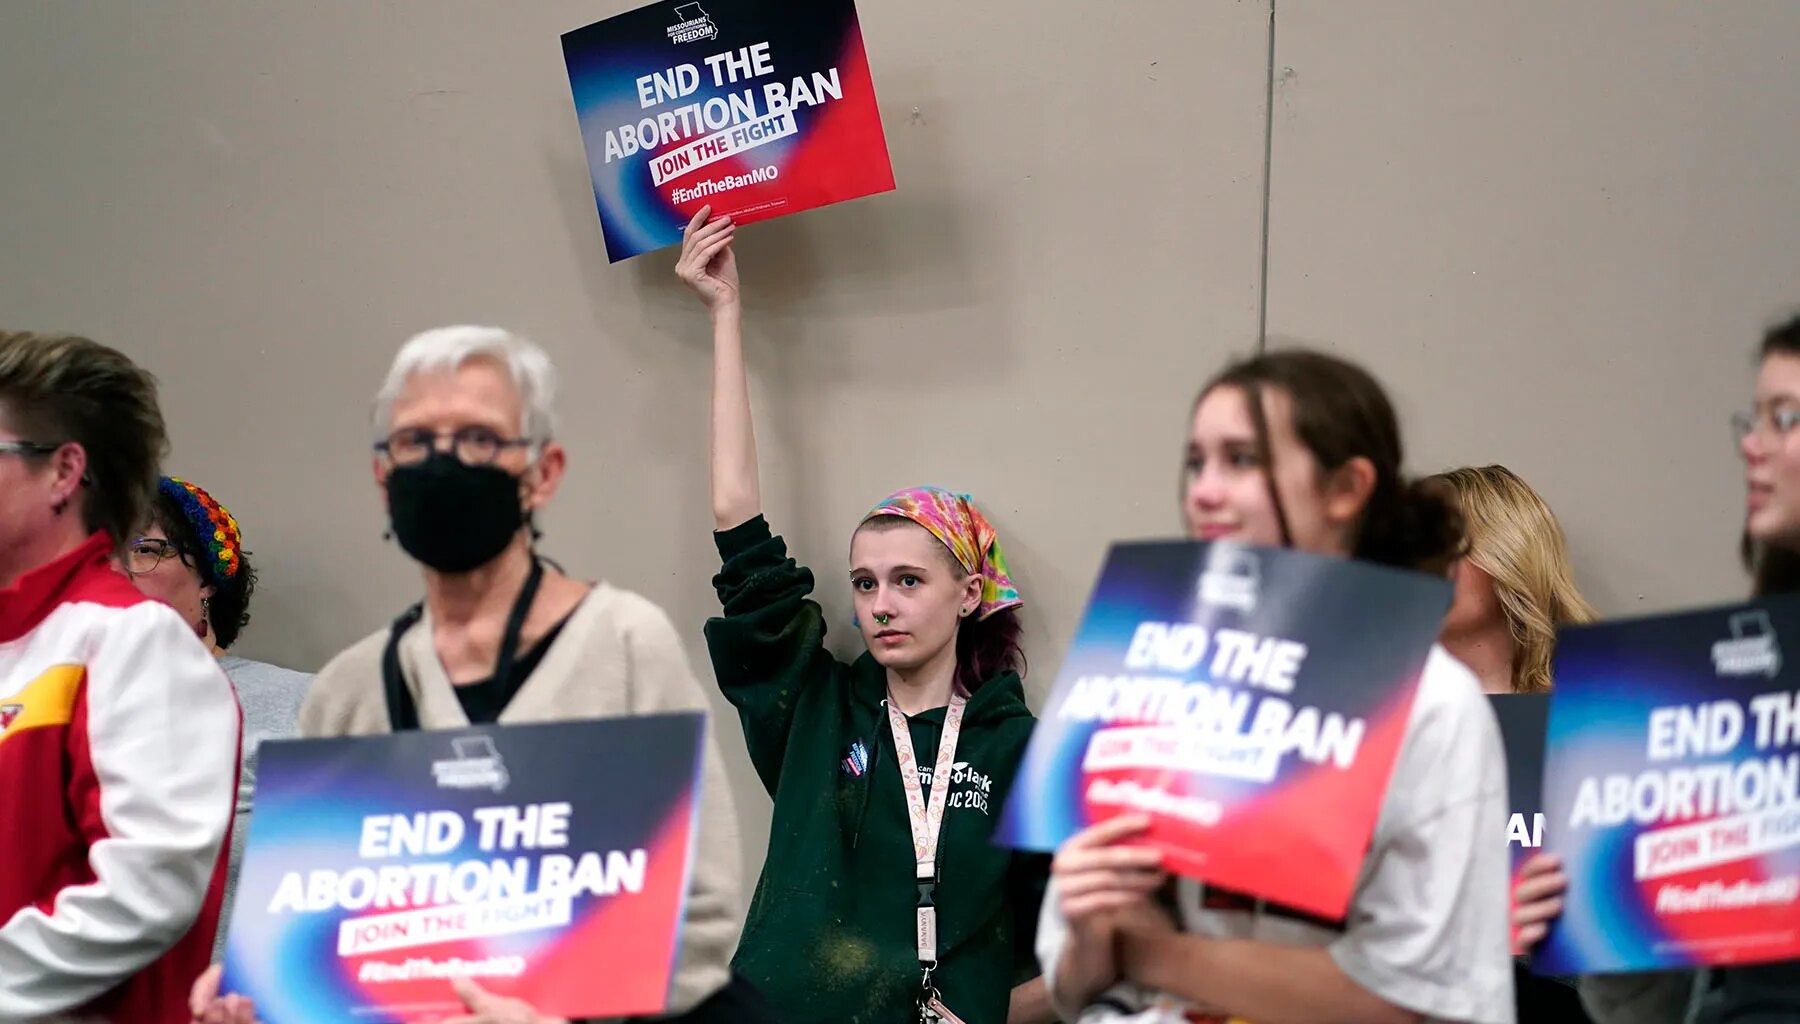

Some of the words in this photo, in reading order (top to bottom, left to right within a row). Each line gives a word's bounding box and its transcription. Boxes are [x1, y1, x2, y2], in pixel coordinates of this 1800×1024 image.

[667, 16, 706, 33] MISSOURIANS
[672, 25, 713, 44] FREEDOM
[636, 63, 700, 109] END
[705, 41, 774, 87] THE
[604, 88, 758, 164] ABORTION
[763, 67, 843, 118] BAN
[656, 147, 691, 182] JOIN
[694, 136, 728, 162] THE
[731, 115, 787, 152] FIGHT
[671, 165, 779, 205] #EndTheBanMO
[1124, 621, 1209, 672] END
[1210, 628, 1307, 693] THE
[1057, 675, 1251, 736] ABORTION
[1253, 697, 1366, 770] BAN
[1647, 700, 1744, 761] END
[1749, 690, 1800, 750] TH
[1569, 752, 1799, 828] ABORTION
[358, 811, 465, 858] END
[474, 803, 572, 851] THE
[268, 857, 529, 914] ABORTION
[538, 849, 647, 899] BAN
[353, 920, 410, 948] JOIN
[423, 912, 467, 935] THE
[481, 897, 555, 924] FIGHT
